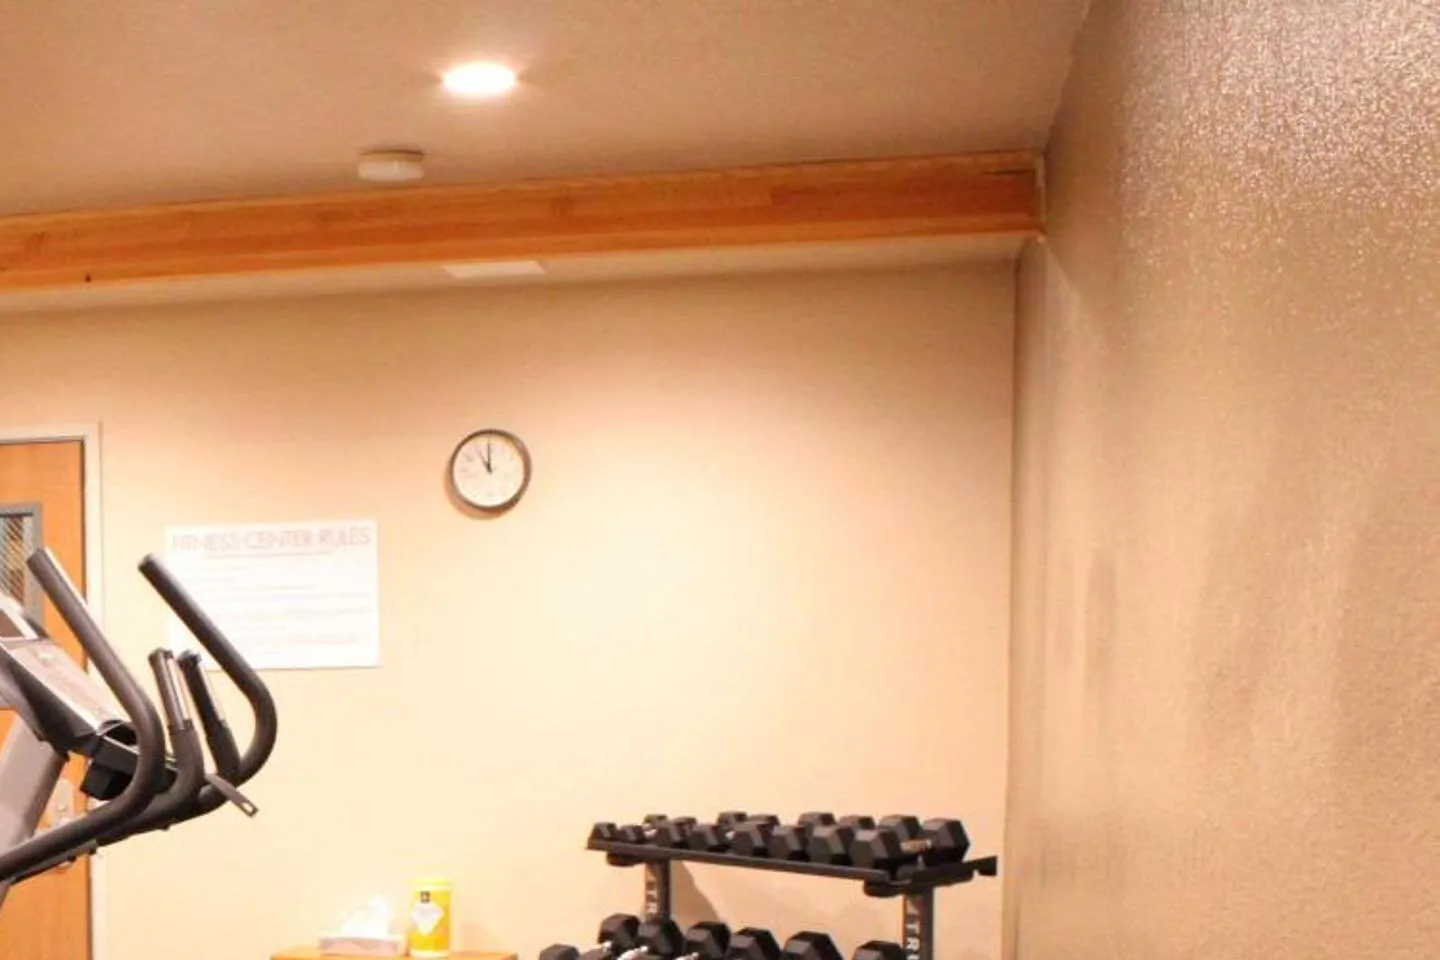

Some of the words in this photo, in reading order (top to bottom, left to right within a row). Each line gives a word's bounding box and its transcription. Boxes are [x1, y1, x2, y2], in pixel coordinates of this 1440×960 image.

[172, 533, 240, 552] FITNESS
[244, 529, 313, 550] CENTER
[318, 526, 372, 547] RULES
